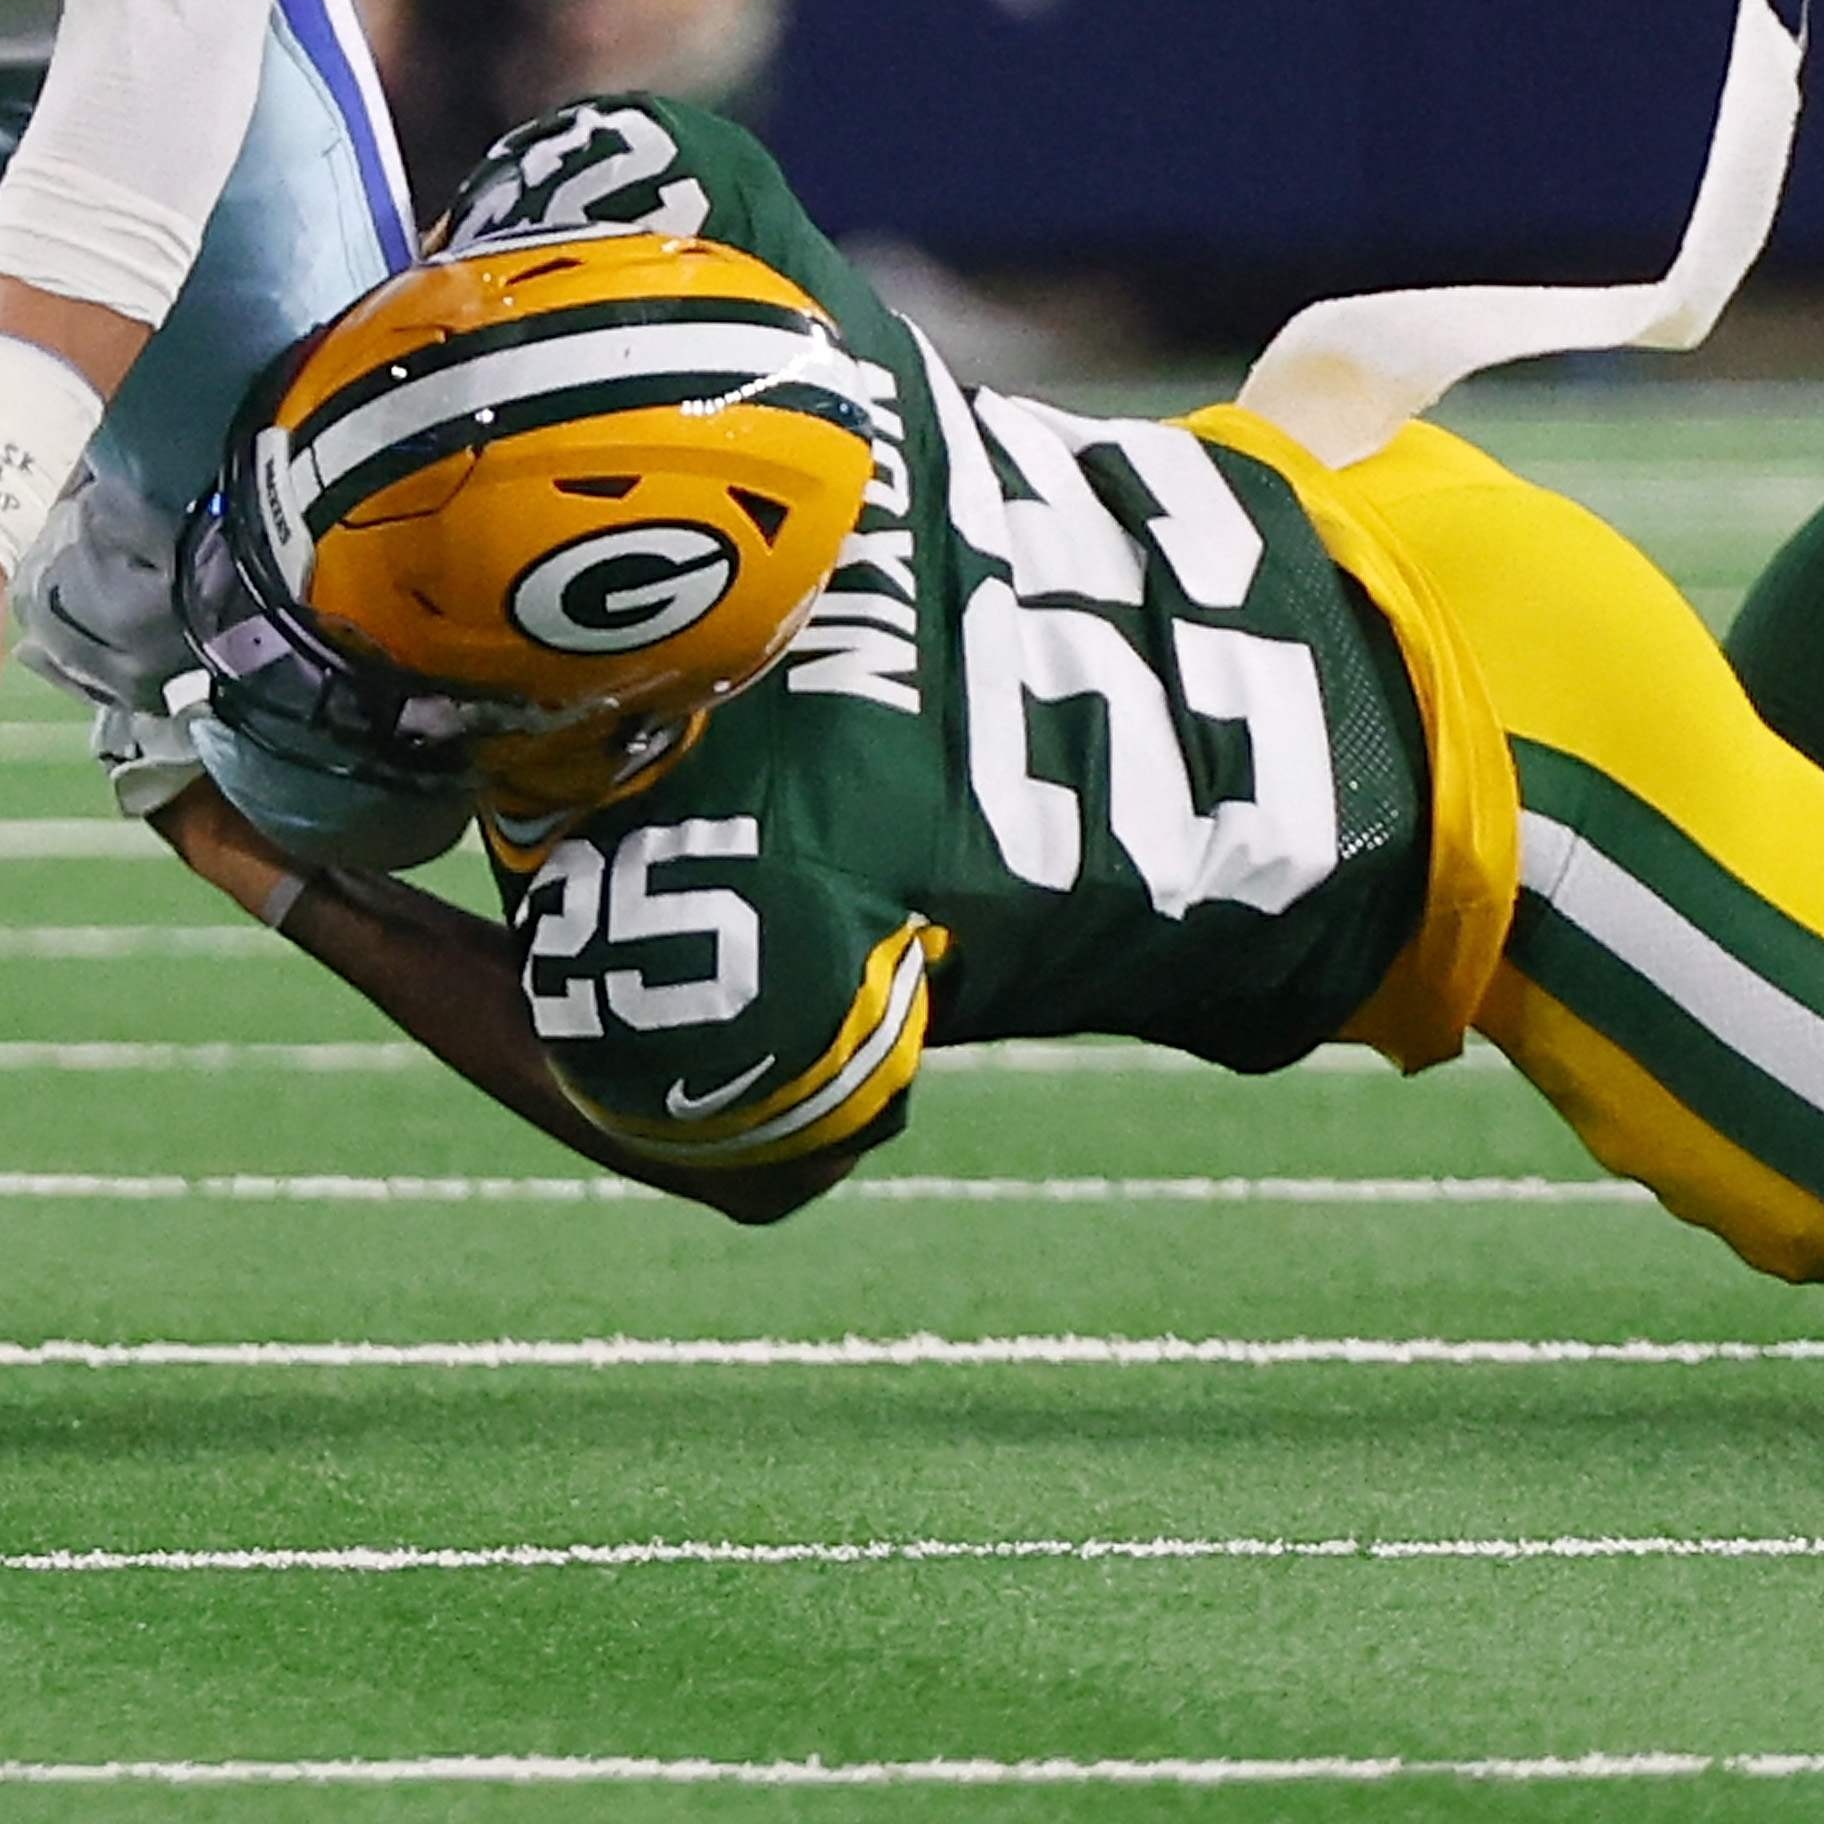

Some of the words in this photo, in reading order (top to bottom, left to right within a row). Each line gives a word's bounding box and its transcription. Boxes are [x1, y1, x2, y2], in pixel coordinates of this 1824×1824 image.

[512, 526, 731, 654] G
[897, 310, 1339, 921] 25
[514, 816, 759, 1038] 25
